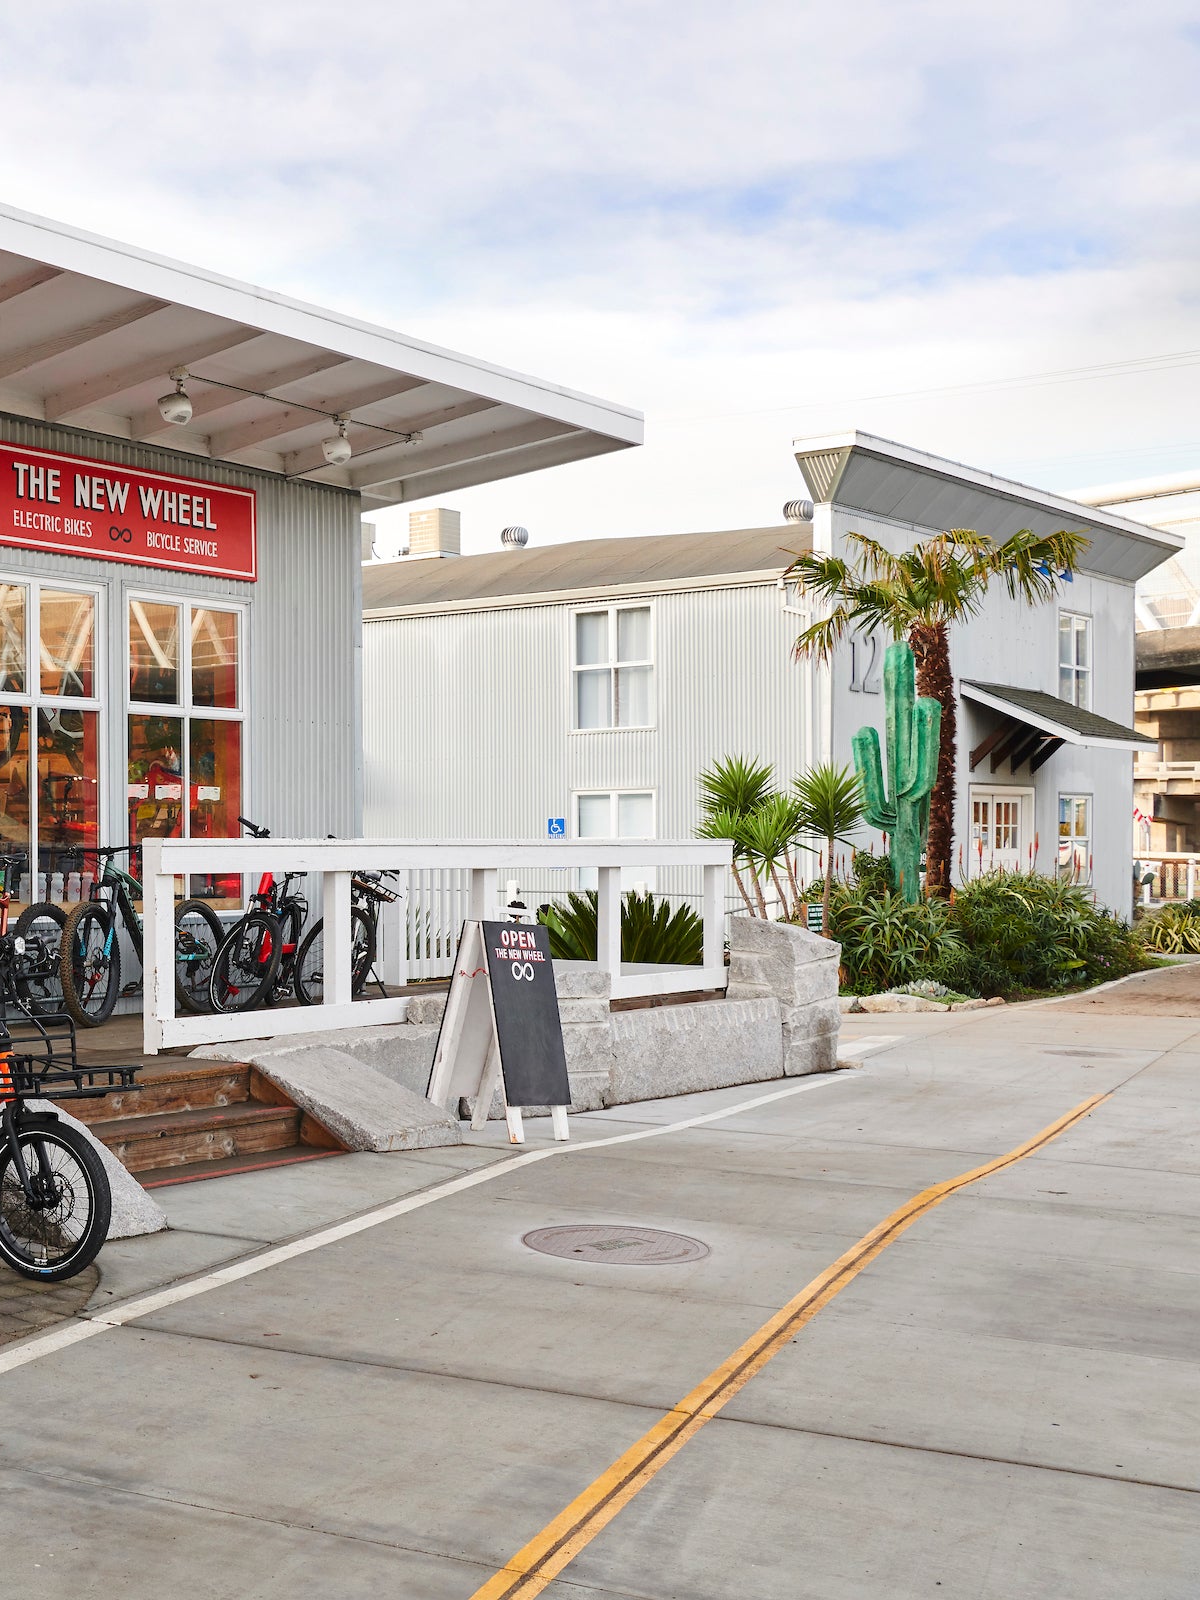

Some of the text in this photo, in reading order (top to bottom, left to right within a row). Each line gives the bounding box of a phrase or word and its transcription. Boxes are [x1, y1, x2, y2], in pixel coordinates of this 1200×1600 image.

[12, 462, 217, 531] THE NEW WHEEL
[13, 509, 93, 538] ELECTRIC BIKES
[146, 531, 218, 557] BICYCLE SERVICE
[501, 930, 536, 948] OPEN
[495, 948, 546, 962] THE NEW WHEEL
